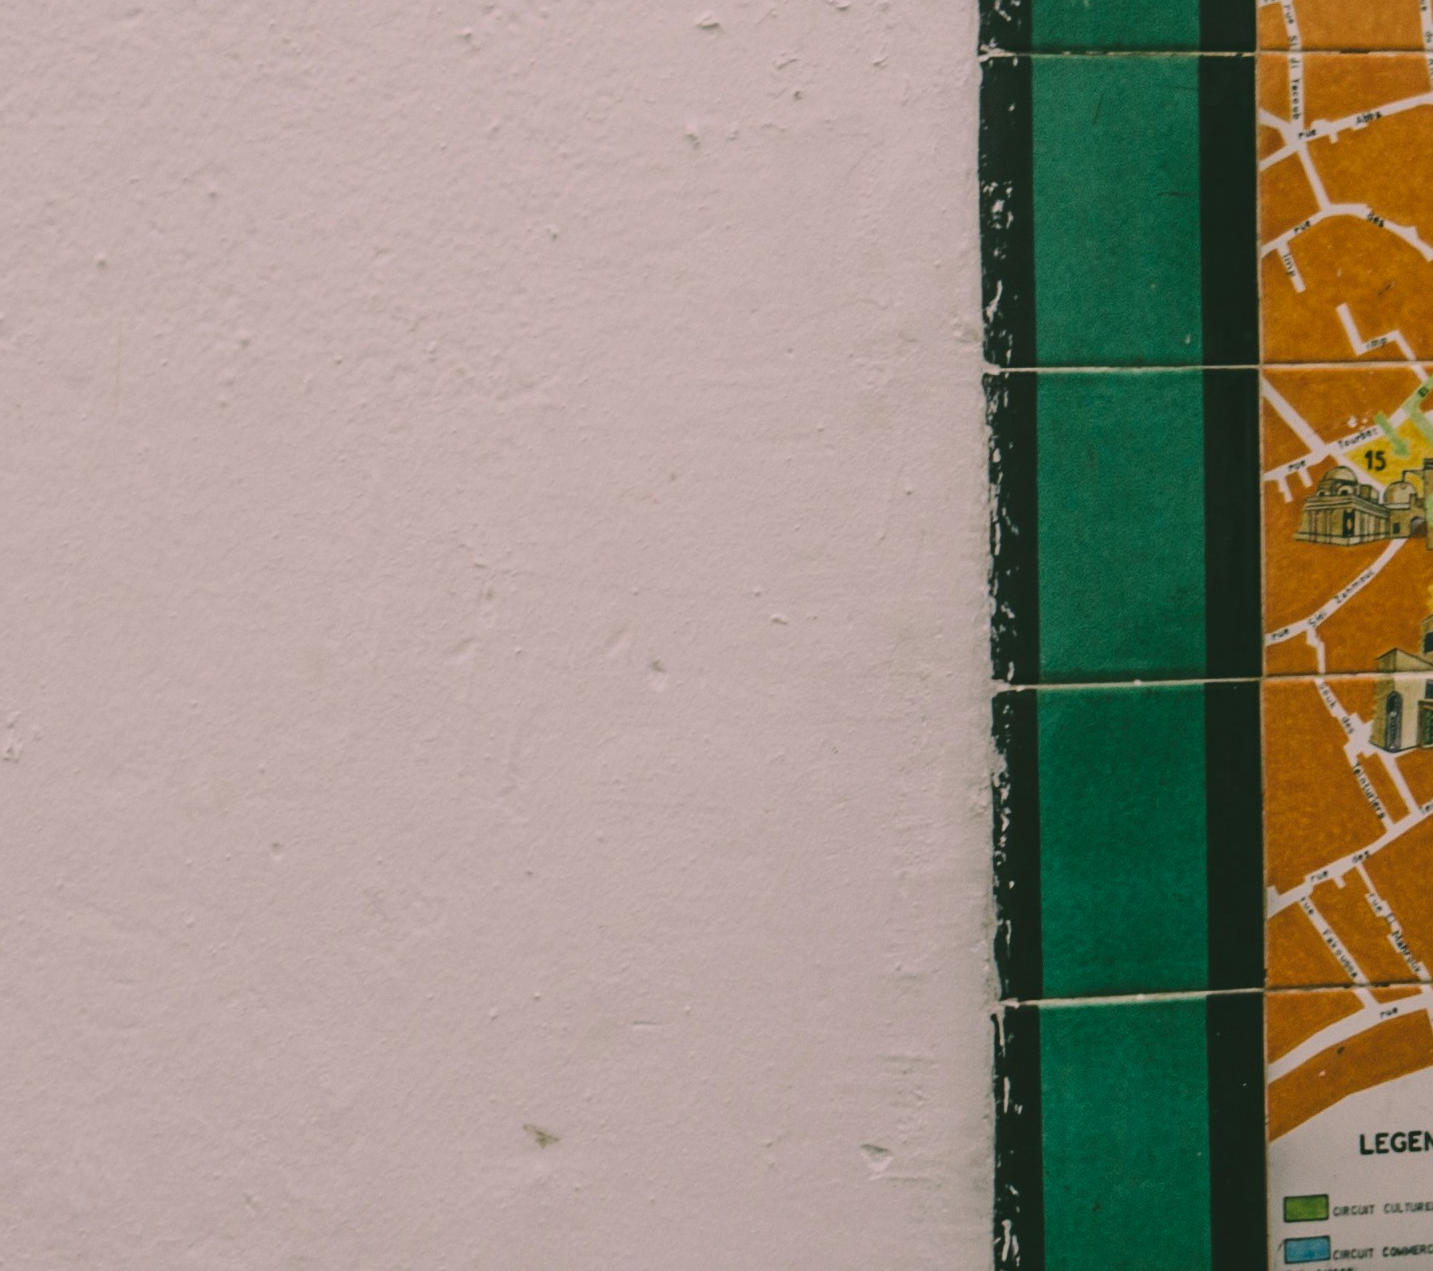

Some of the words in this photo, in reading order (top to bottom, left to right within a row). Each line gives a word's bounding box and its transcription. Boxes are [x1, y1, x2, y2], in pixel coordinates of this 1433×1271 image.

[1364, 450, 1387, 472] 15
[1332, 1204, 1375, 1217] CIRCUIT
[1333, 1247, 1375, 1261] CIRCUIT
